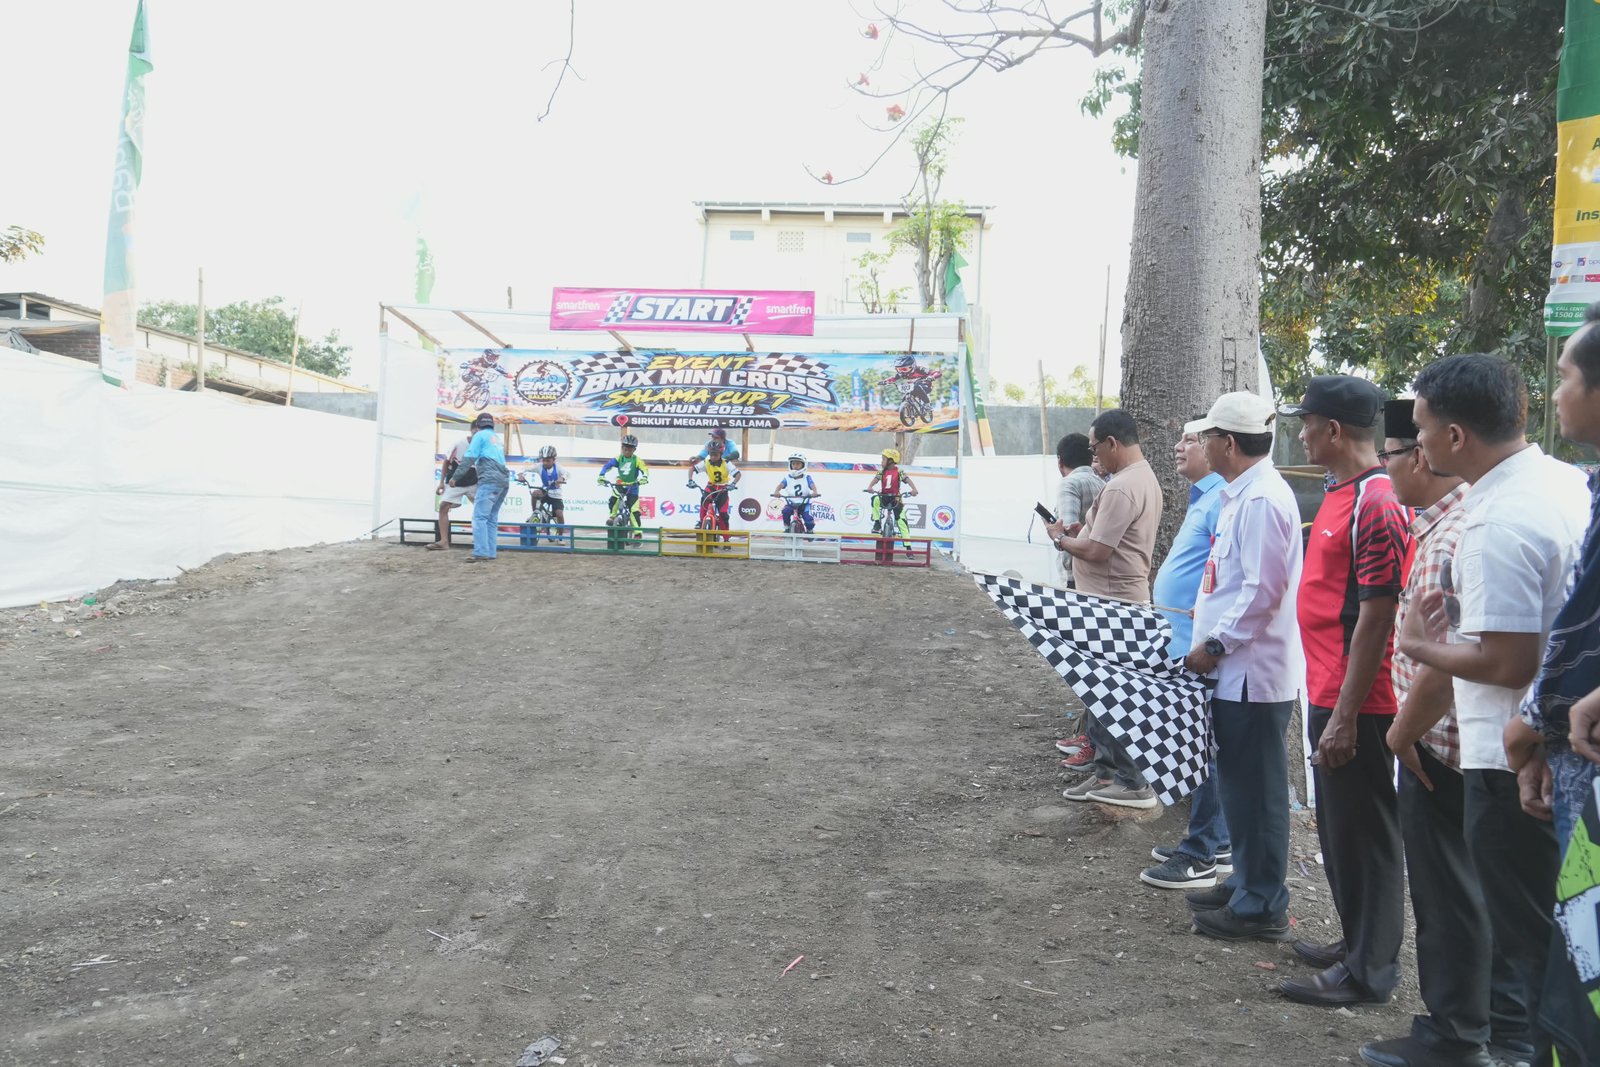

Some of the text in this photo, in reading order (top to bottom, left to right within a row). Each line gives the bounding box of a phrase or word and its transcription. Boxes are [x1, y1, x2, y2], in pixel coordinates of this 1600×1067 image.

[1576, 209, 1600, 222] Ins
[556, 300, 600, 311] smartfren
[632, 297, 733, 320] START
[766, 304, 811, 314] smartfren
[647, 356, 754, 370] EVENT
[517, 382, 567, 391] BMX
[579, 370, 657, 395] BMX
[660, 369, 722, 384] MINI
[729, 371, 831, 401] CROSS
[600, 388, 790, 409] SALAMA CUP 7
[643, 404, 702, 413] TAHUN
[631, 417, 671, 425] SIRKUIT
[674, 418, 719, 427] MEGARIA
[729, 419, 771, 427] SALAMA
[620, 461, 632, 475] 4
[714, 471, 722, 482] 3
[885, 474, 893, 489] 1
[794, 484, 803, 497] 2
